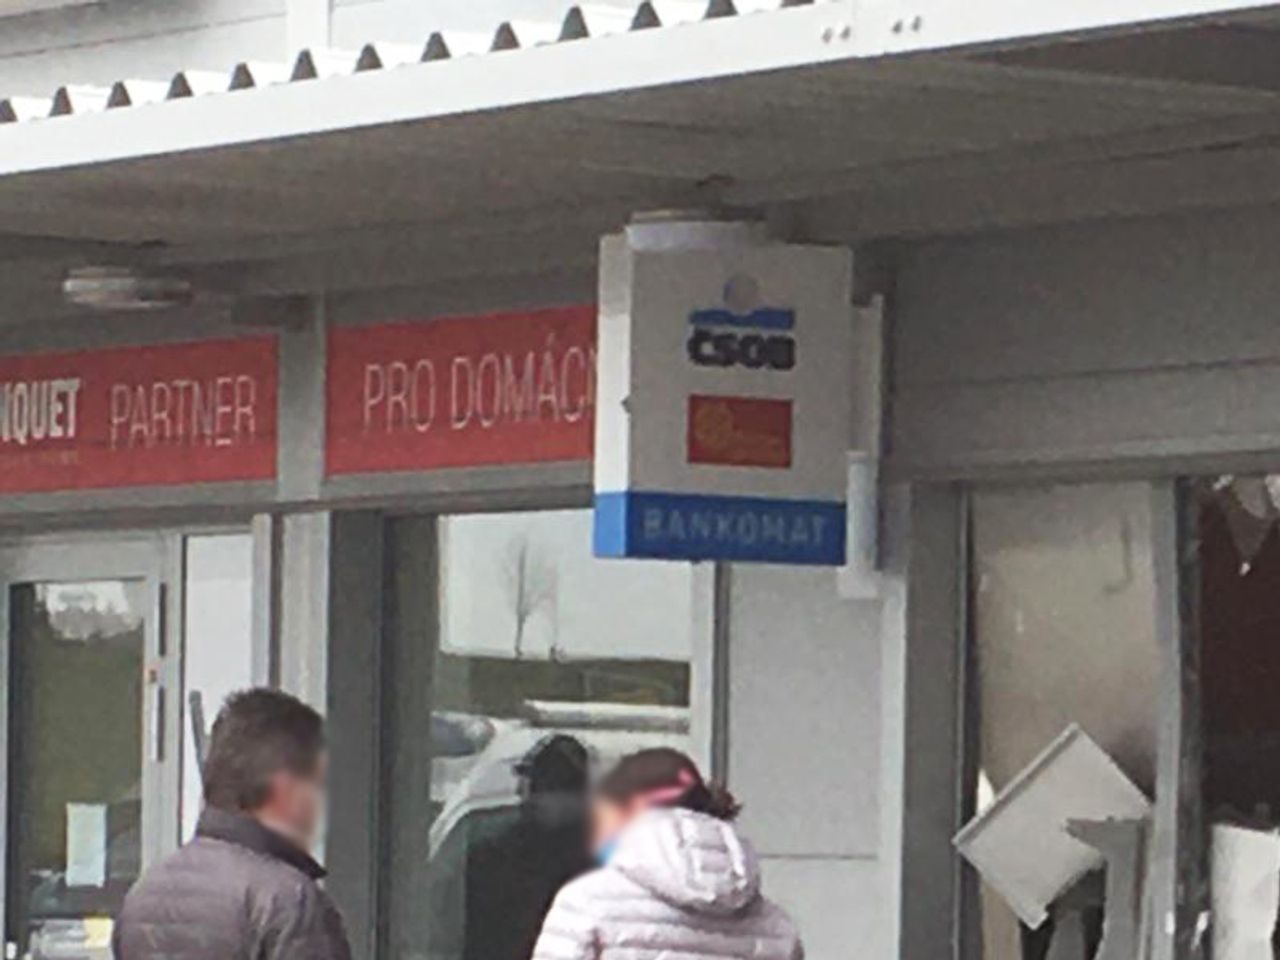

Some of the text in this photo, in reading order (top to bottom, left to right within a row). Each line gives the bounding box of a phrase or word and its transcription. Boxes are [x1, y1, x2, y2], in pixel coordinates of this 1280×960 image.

[109, 374, 256, 451] PARTNER
[364, 358, 437, 434] PRO
[644, 506, 826, 547] BANKOMAT
